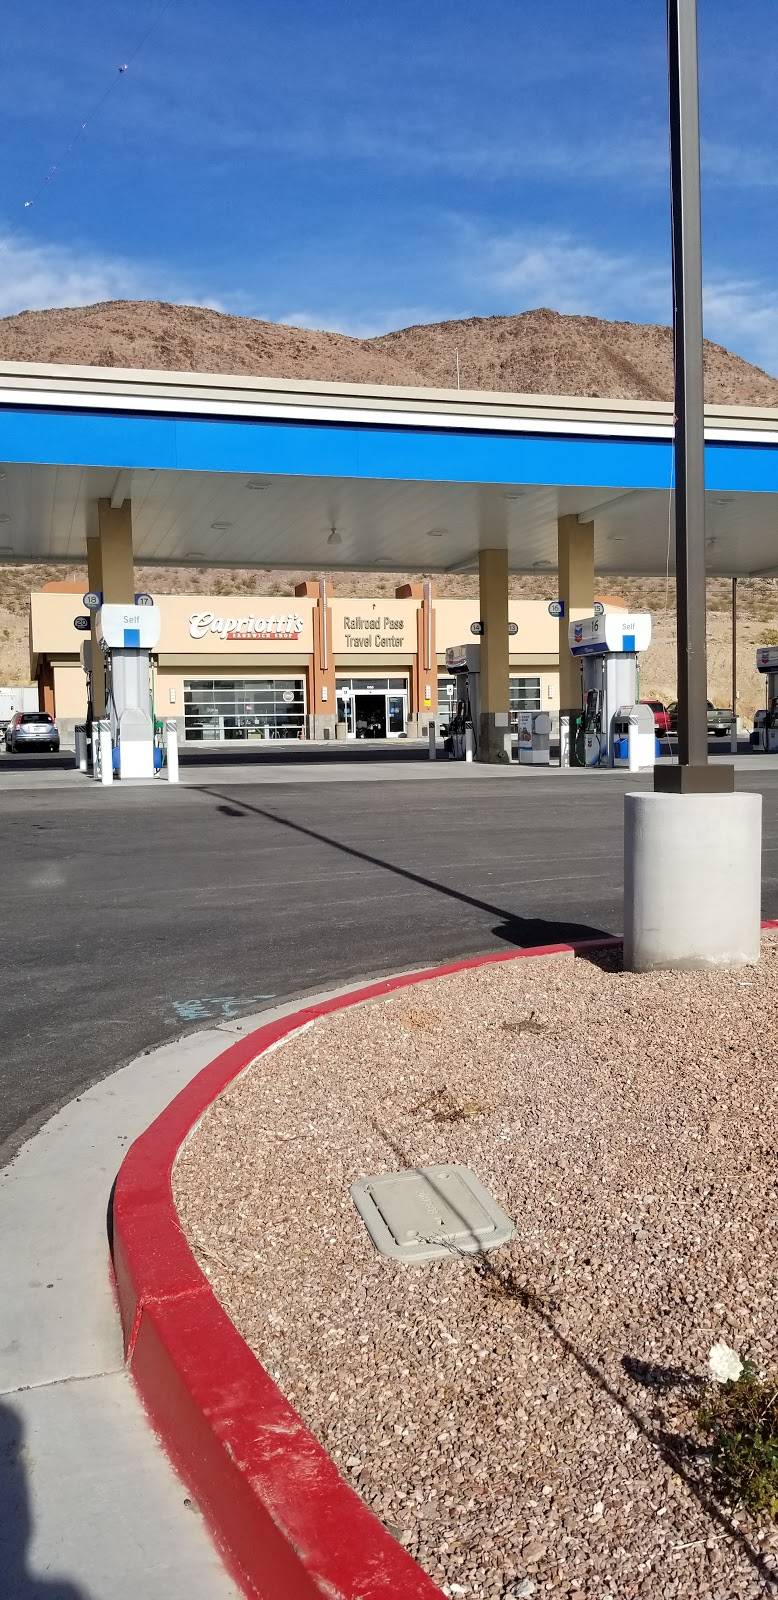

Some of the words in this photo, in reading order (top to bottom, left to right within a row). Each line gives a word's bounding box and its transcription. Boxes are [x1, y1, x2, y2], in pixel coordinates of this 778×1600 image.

[123, 616, 140, 624] Self
[188, 611, 304, 640] Capriotti's
[343, 616, 381, 629] Railroad
[383, 616, 405, 629] Pass
[592, 619, 599, 632] 16
[622, 623, 635, 631] Self
[345, 634, 372, 647] Travel
[375, 634, 405, 647] Center
